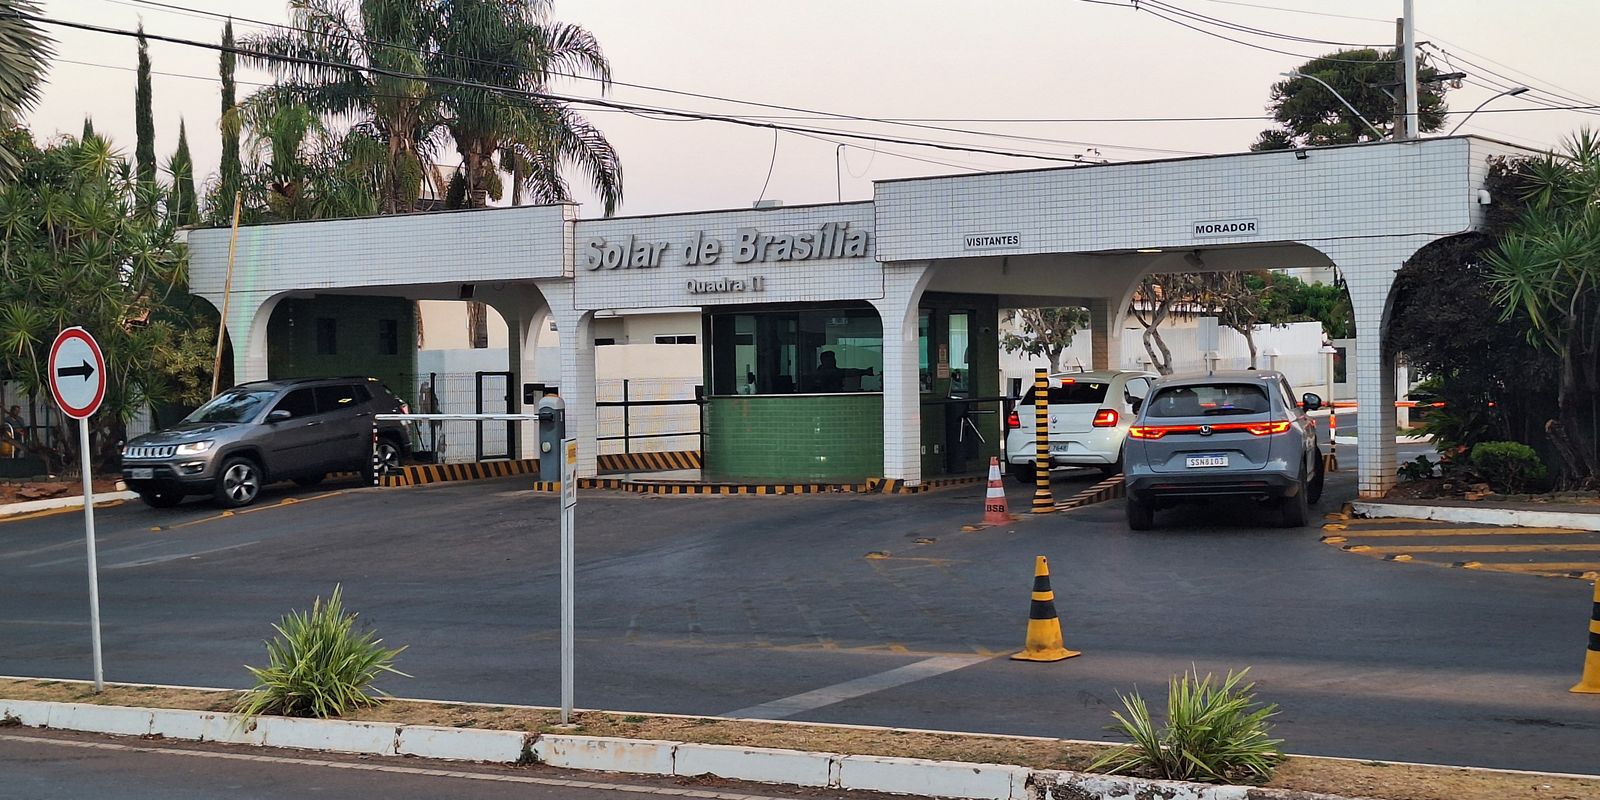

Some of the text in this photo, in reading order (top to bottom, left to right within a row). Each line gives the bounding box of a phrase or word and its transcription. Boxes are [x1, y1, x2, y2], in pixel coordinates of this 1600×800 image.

[1195, 222, 1256, 234] MORADOR
[584, 221, 870, 271] Solar de Brasília
[966, 235, 1019, 247] VISITANTES
[686, 277, 745, 294] Quadra
[986, 504, 1005, 513] BSB
